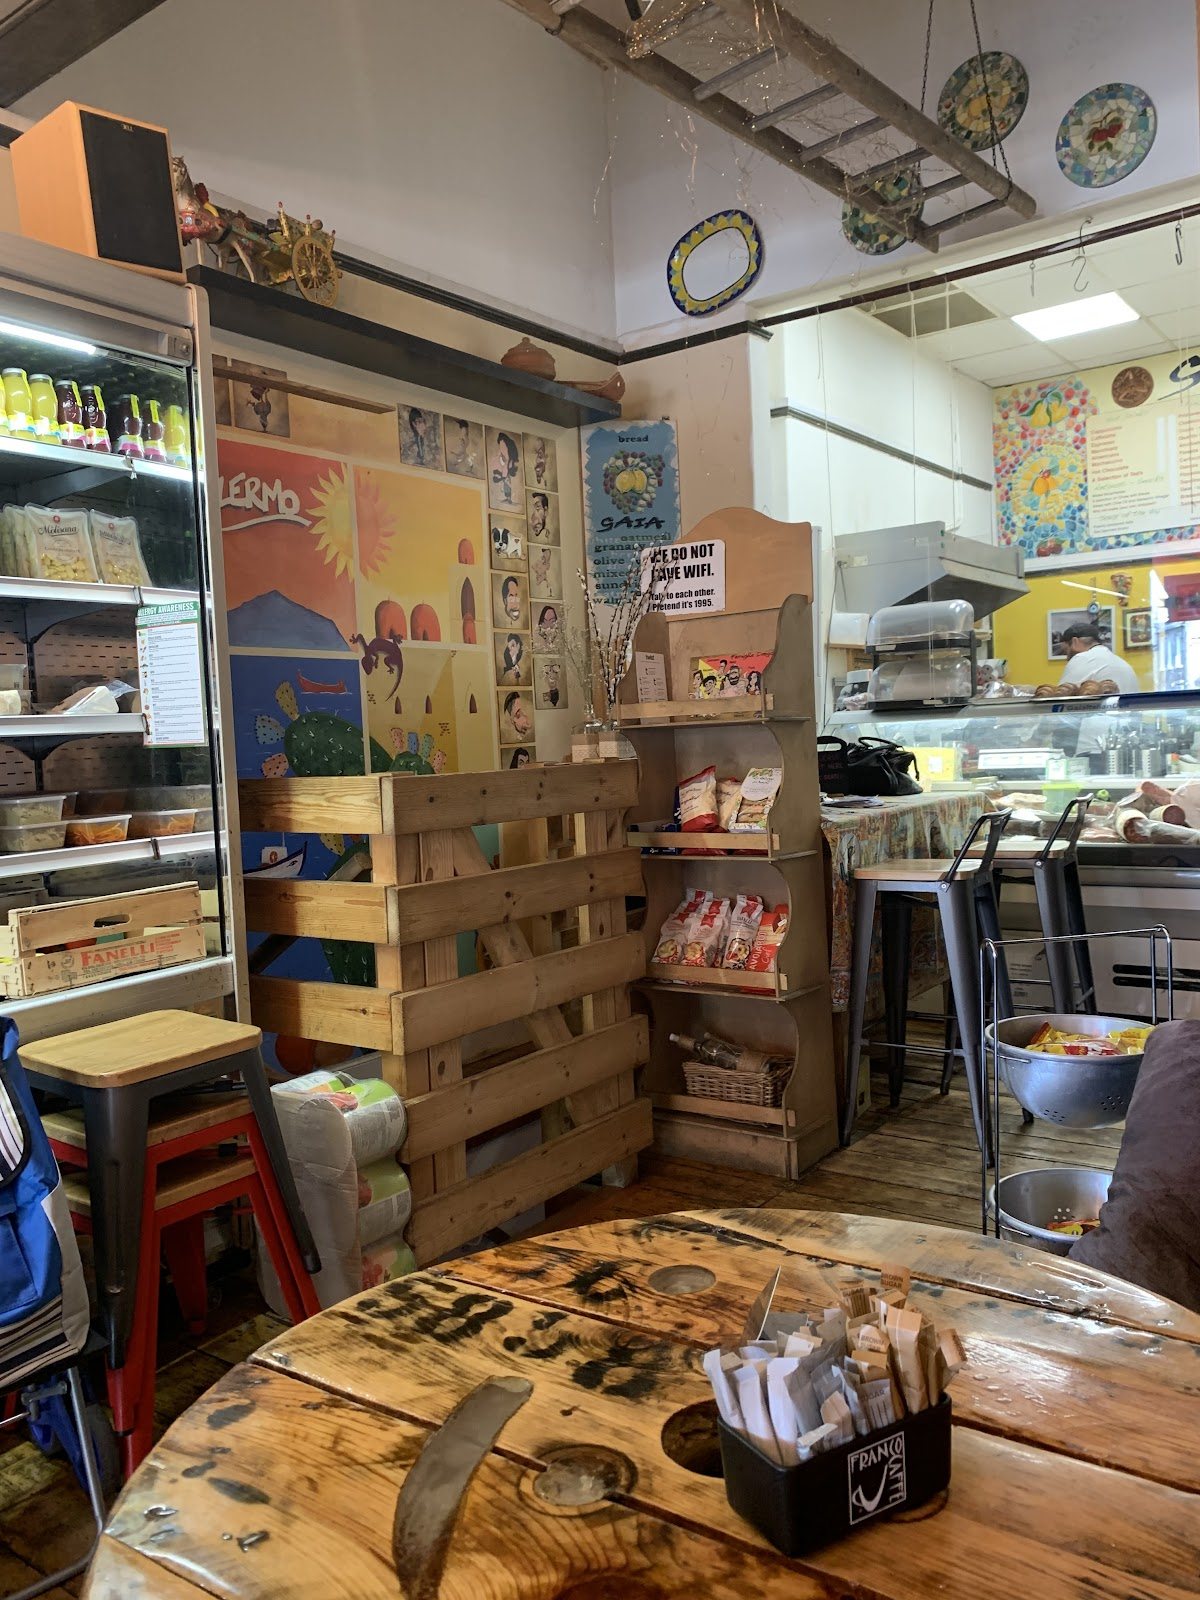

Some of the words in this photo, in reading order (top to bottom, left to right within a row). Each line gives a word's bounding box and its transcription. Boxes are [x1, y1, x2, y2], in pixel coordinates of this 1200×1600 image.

[618, 434, 649, 443] bread
[219, 472, 301, 516] LERMO
[596, 516, 665, 532] GAIA
[620, 532, 671, 541] oatmeal
[594, 543, 645, 552] granary
[671, 546, 688, 560] DO
[690, 543, 715, 559] NOT
[593, 557, 625, 565] olive
[683, 563, 715, 579] WIFI.
[666, 592, 674, 600] to
[675, 590, 693, 599] each
[694, 588, 716, 597] other.
[158, 602, 194, 614] AWARENESS
[682, 600, 693, 609] it's
[694, 598, 714, 608] 1995.
[81, 943, 155, 968] FANELLI
[750, 930, 767, 970] AVOIARDI
[850, 1436, 903, 1474] FRANCO
